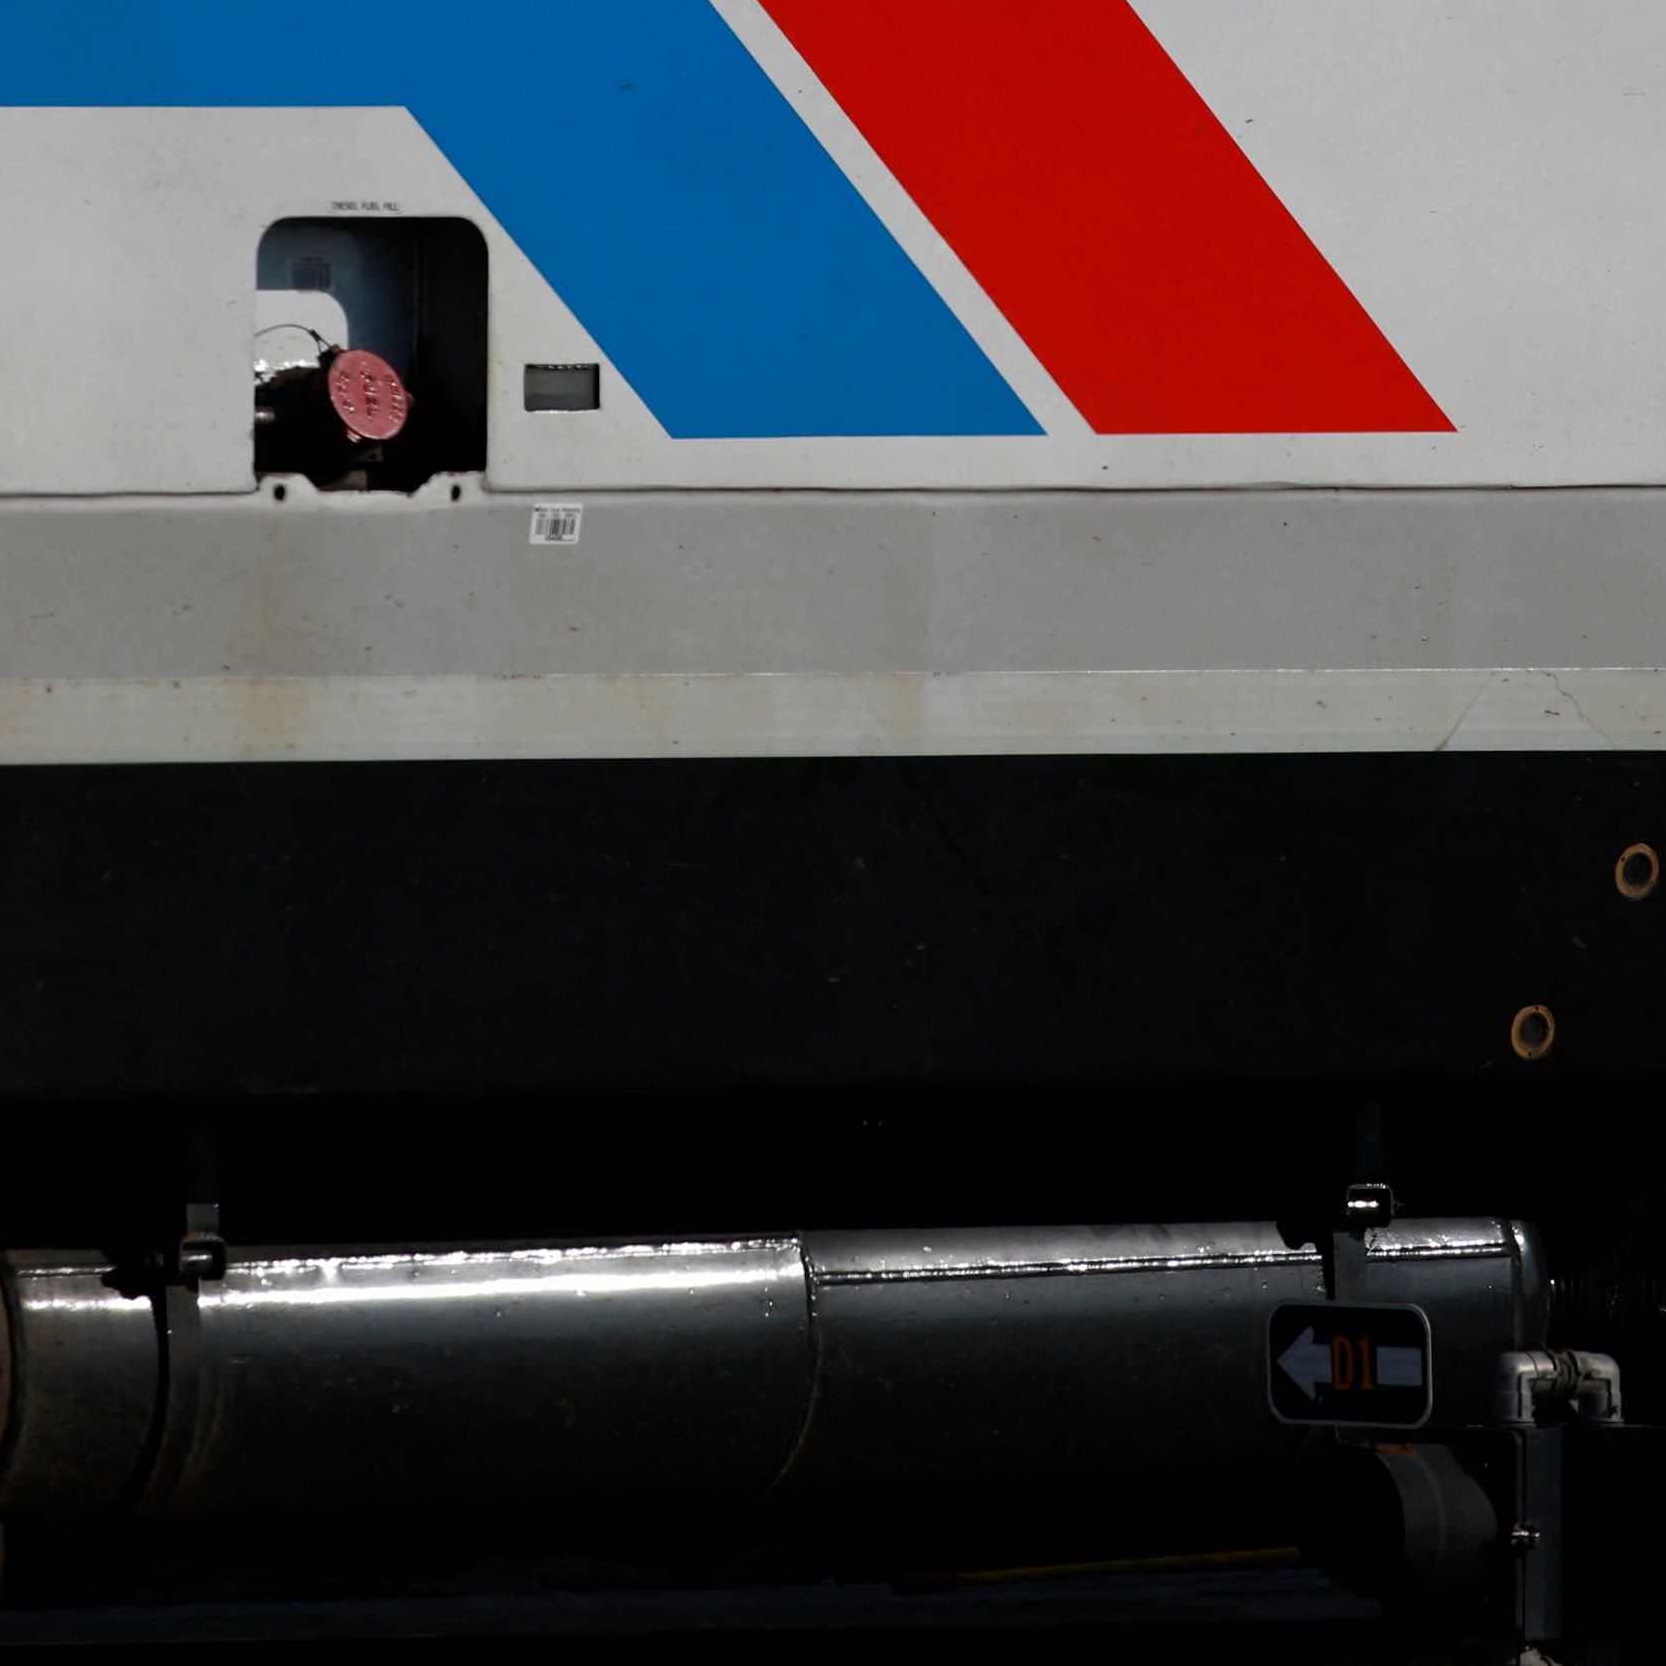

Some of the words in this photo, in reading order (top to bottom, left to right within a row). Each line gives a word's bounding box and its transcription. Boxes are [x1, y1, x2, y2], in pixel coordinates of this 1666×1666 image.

[331, 201, 358, 211] DIESEL
[360, 201, 380, 211] FUEL
[1331, 1336, 1374, 1391] D1
